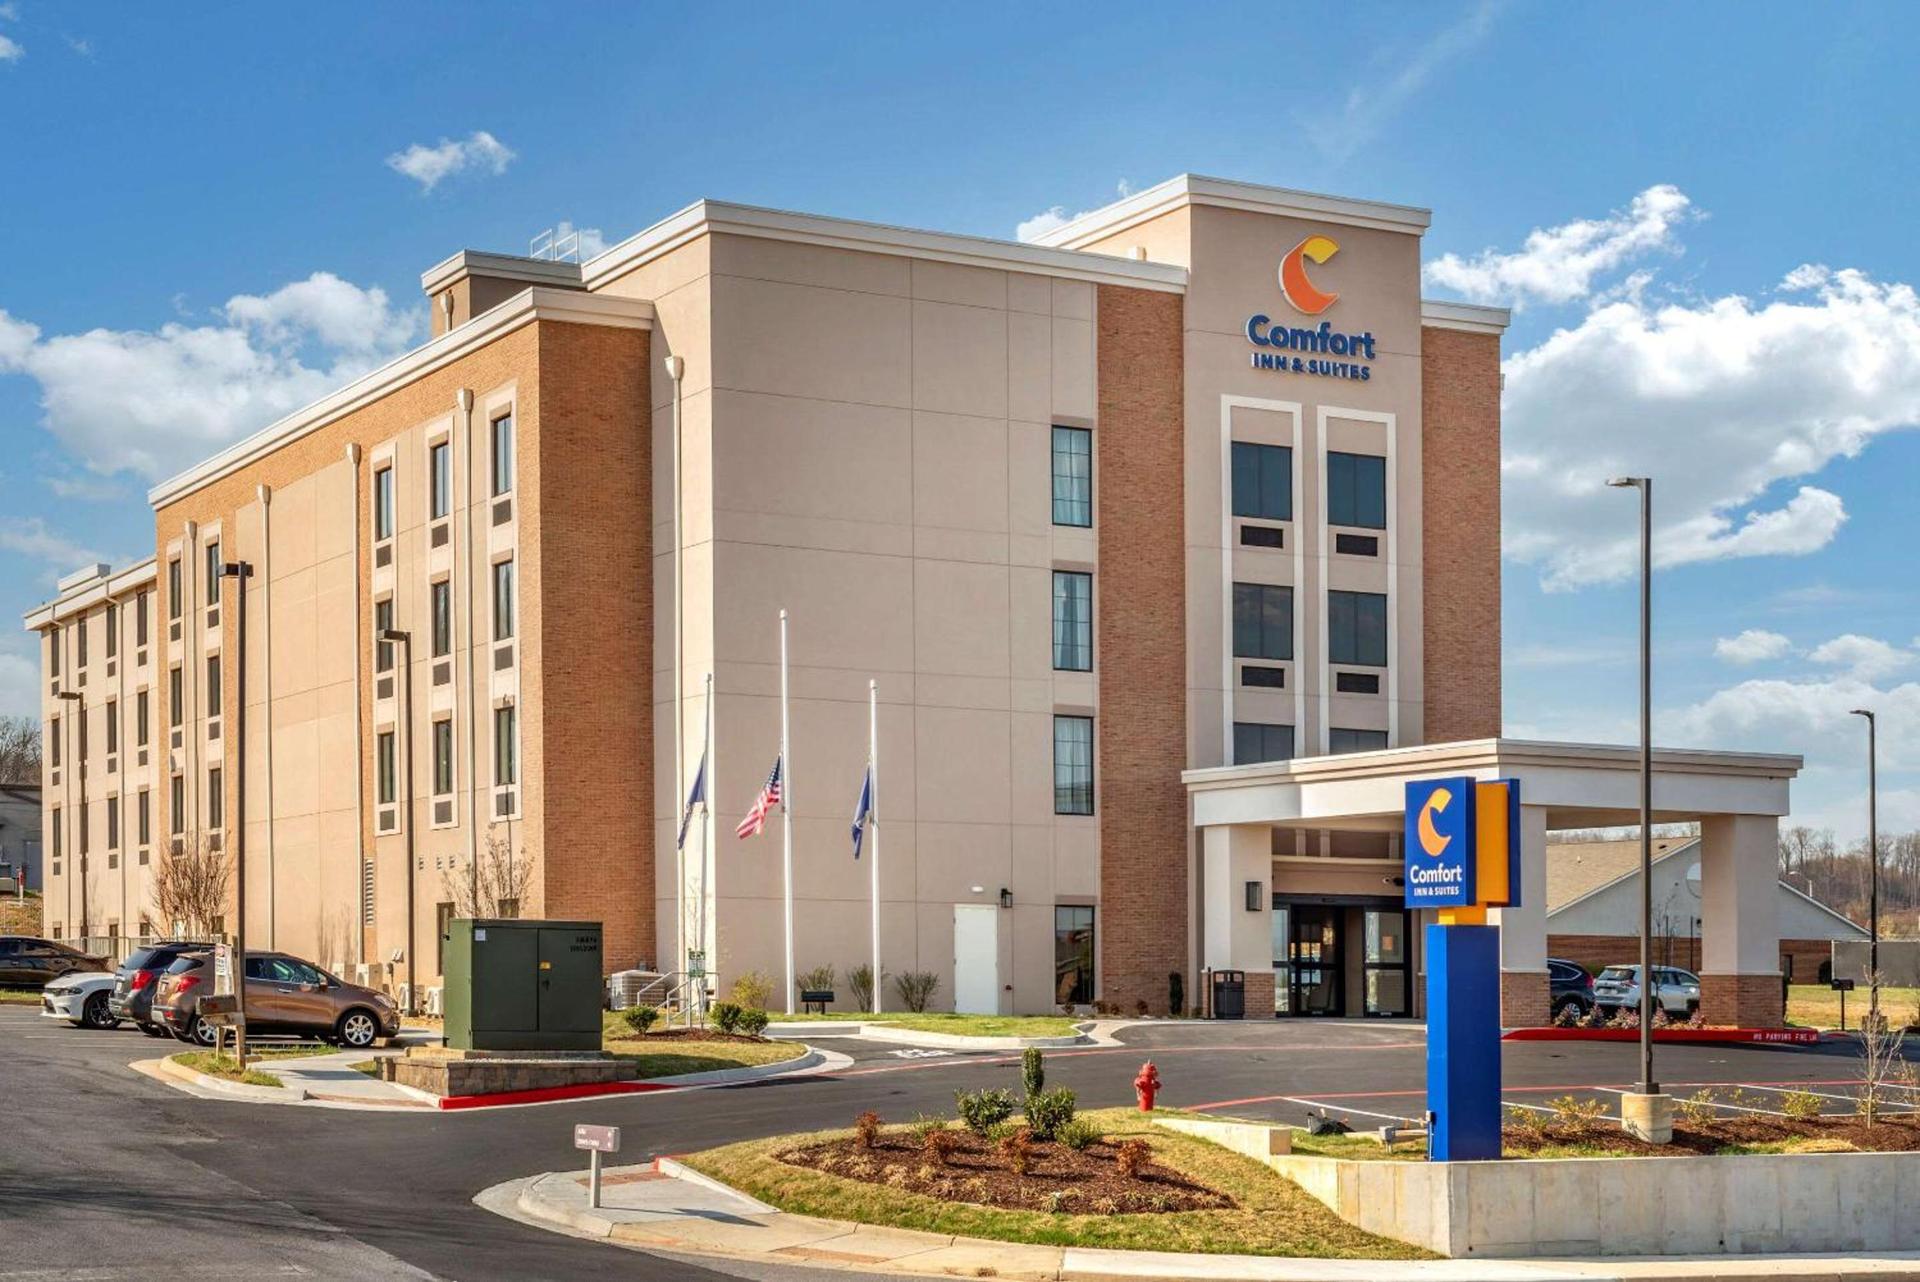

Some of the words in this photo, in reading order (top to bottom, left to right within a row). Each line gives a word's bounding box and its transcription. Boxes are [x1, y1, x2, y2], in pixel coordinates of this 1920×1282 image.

[1246, 314, 1376, 360] Comfort
[1251, 352, 1287, 371] INN
[1290, 357, 1304, 373] &
[1307, 358, 1370, 381] SUITES
[1410, 862, 1463, 884] Comfort
[1413, 887, 1428, 897] INN
[1434, 886, 1460, 896] SUITES
